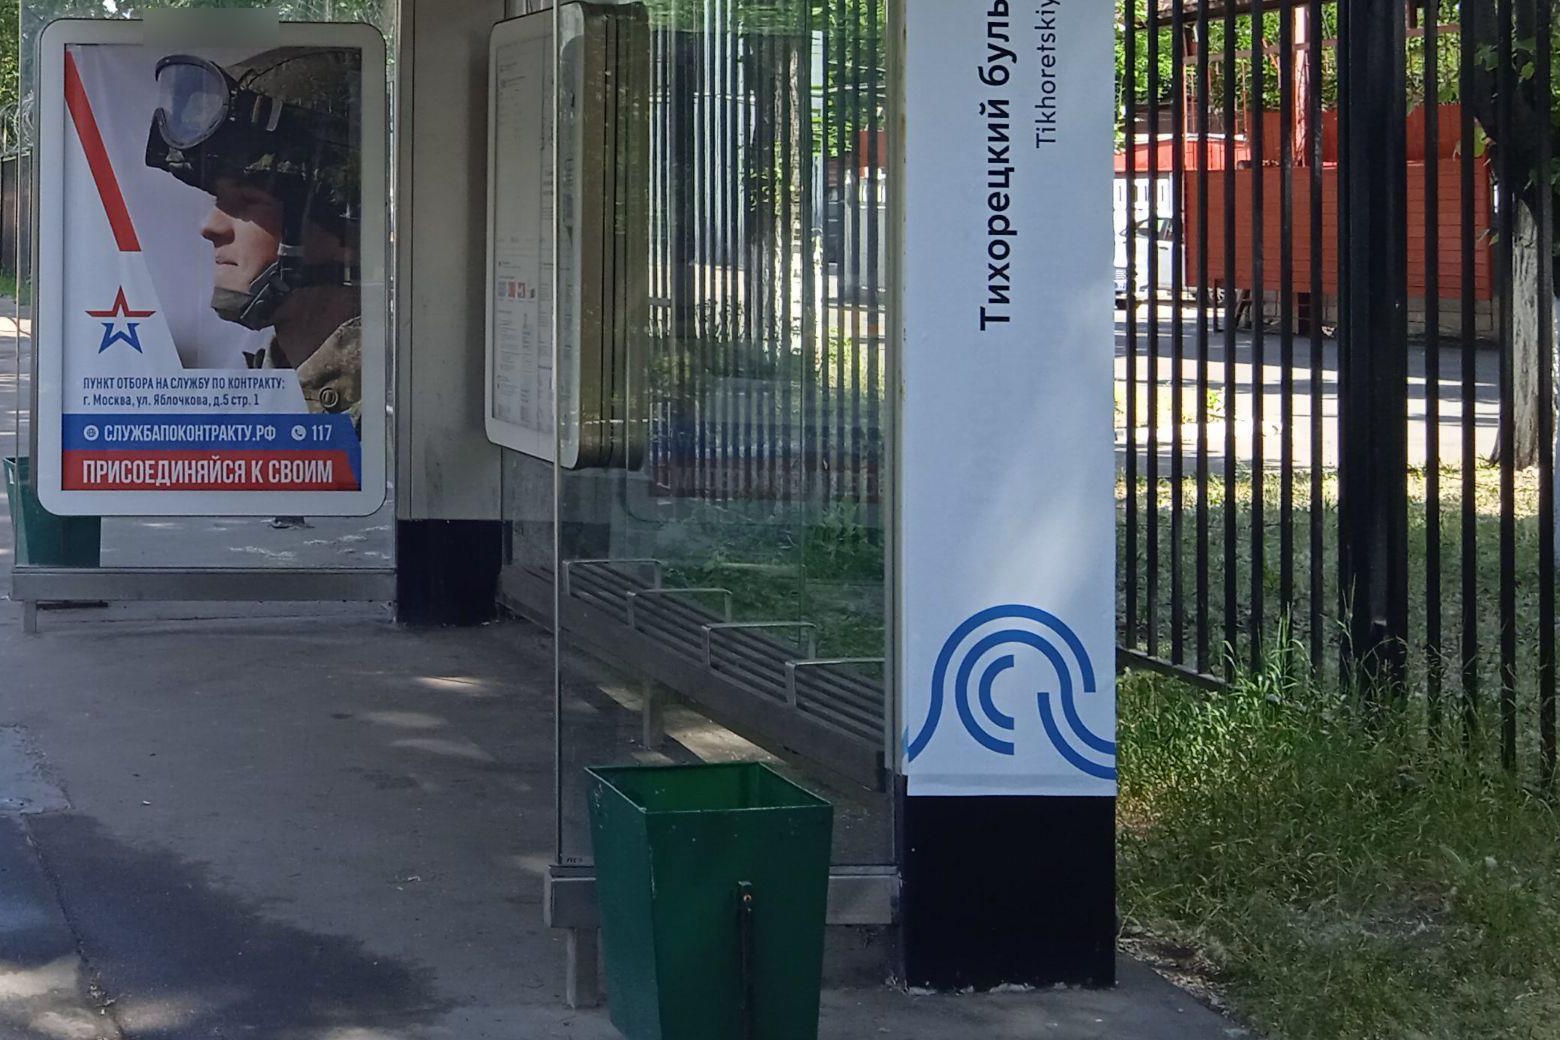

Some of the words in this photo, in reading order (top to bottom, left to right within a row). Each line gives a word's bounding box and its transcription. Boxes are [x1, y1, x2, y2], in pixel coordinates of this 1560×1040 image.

[979, 98, 1017, 331] Тихорецкий
[83, 377, 116, 389] ПУНКТ
[117, 377, 154, 389] ОТБОРА
[156, 377, 169, 389] НА
[170, 377, 210, 389] СЛУЖБУ
[212, 377, 225, 389] ПО
[228, 377, 285, 389] КОНТРАКТУ:
[83, 396, 91, 406] г.
[93, 394, 135, 407] Москва,
[136, 396, 151, 407] ул.
[153, 394, 211, 407] Яблочкова,
[231, 396, 251, 407] стр.
[254, 394, 259, 405] 1
[104, 424, 276, 441] СЛУЖБАПОКОНТРАКТУ.РФ
[311, 425, 332, 441] 117
[83, 455, 245, 486] ПРИСОЕДИНЯЙСЯ
[251, 460, 264, 484] К
[268, 460, 333, 484] СВОИМ
